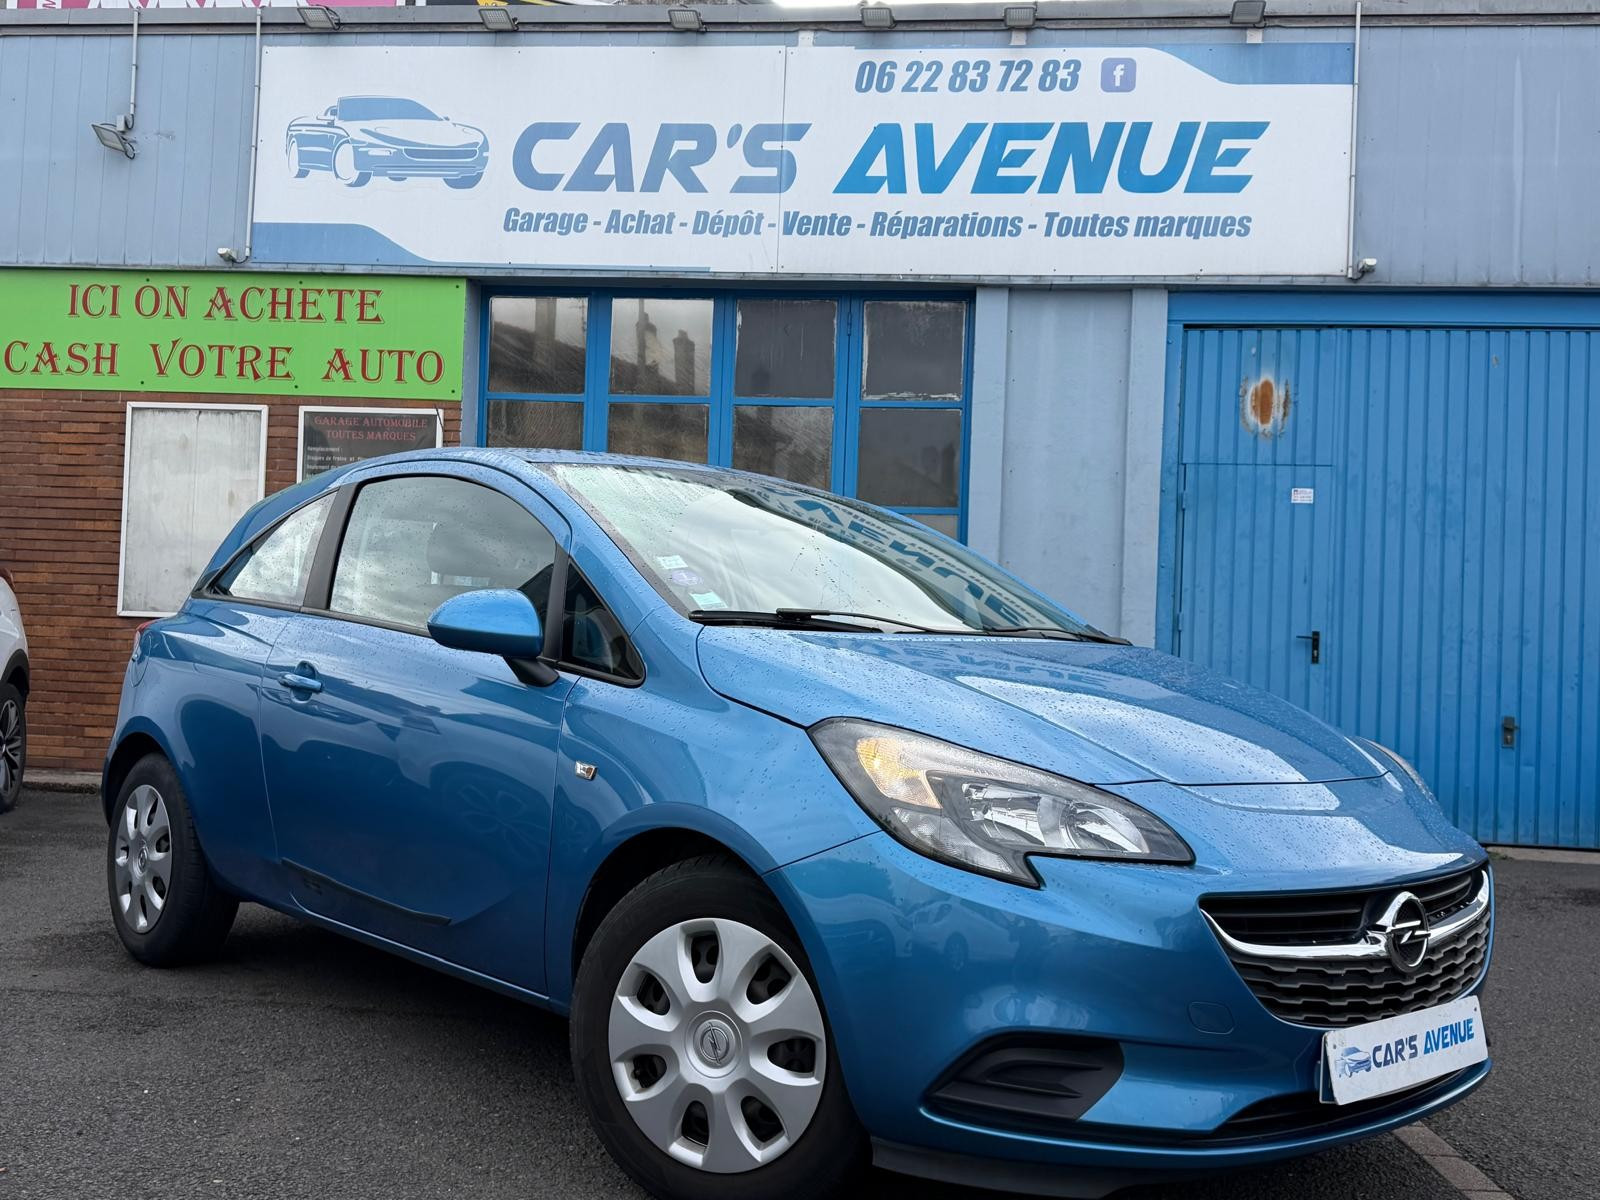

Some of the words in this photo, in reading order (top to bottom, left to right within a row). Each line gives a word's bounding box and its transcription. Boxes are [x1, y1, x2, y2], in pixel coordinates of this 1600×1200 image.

[855, 61, 898, 94] 06
[901, 60, 944, 93] 22
[948, 59, 992, 93] 83
[996, 59, 1034, 92] 72
[1038, 58, 1082, 92] 83
[512, 121, 813, 194] CAR'S
[832, 120, 1271, 194] AVENUE
[503, 207, 589, 236] Garage
[604, 208, 677, 236] Achat
[691, 209, 765, 238] Dépôt
[782, 211, 852, 237] Vente
[869, 211, 1024, 240] Réparations
[1043, 211, 1130, 238] Toutes
[1133, 212, 1252, 240] marques
[70, 284, 121, 318] ICI
[135, 285, 190, 319] ON
[205, 287, 385, 324] ACHETE
[4, 341, 120, 376] CASH
[149, 338, 294, 382] VOTRE
[322, 348, 445, 384] AUTO
[314, 416, 360, 426] GARAGE
[363, 417, 428, 429] AUTOMOBILE
[326, 430, 364, 440] TOUTES
[366, 431, 417, 441] MARQUES
[1372, 1034, 1418, 1068] CAR'S
[1423, 1018, 1475, 1055] AVENUE
